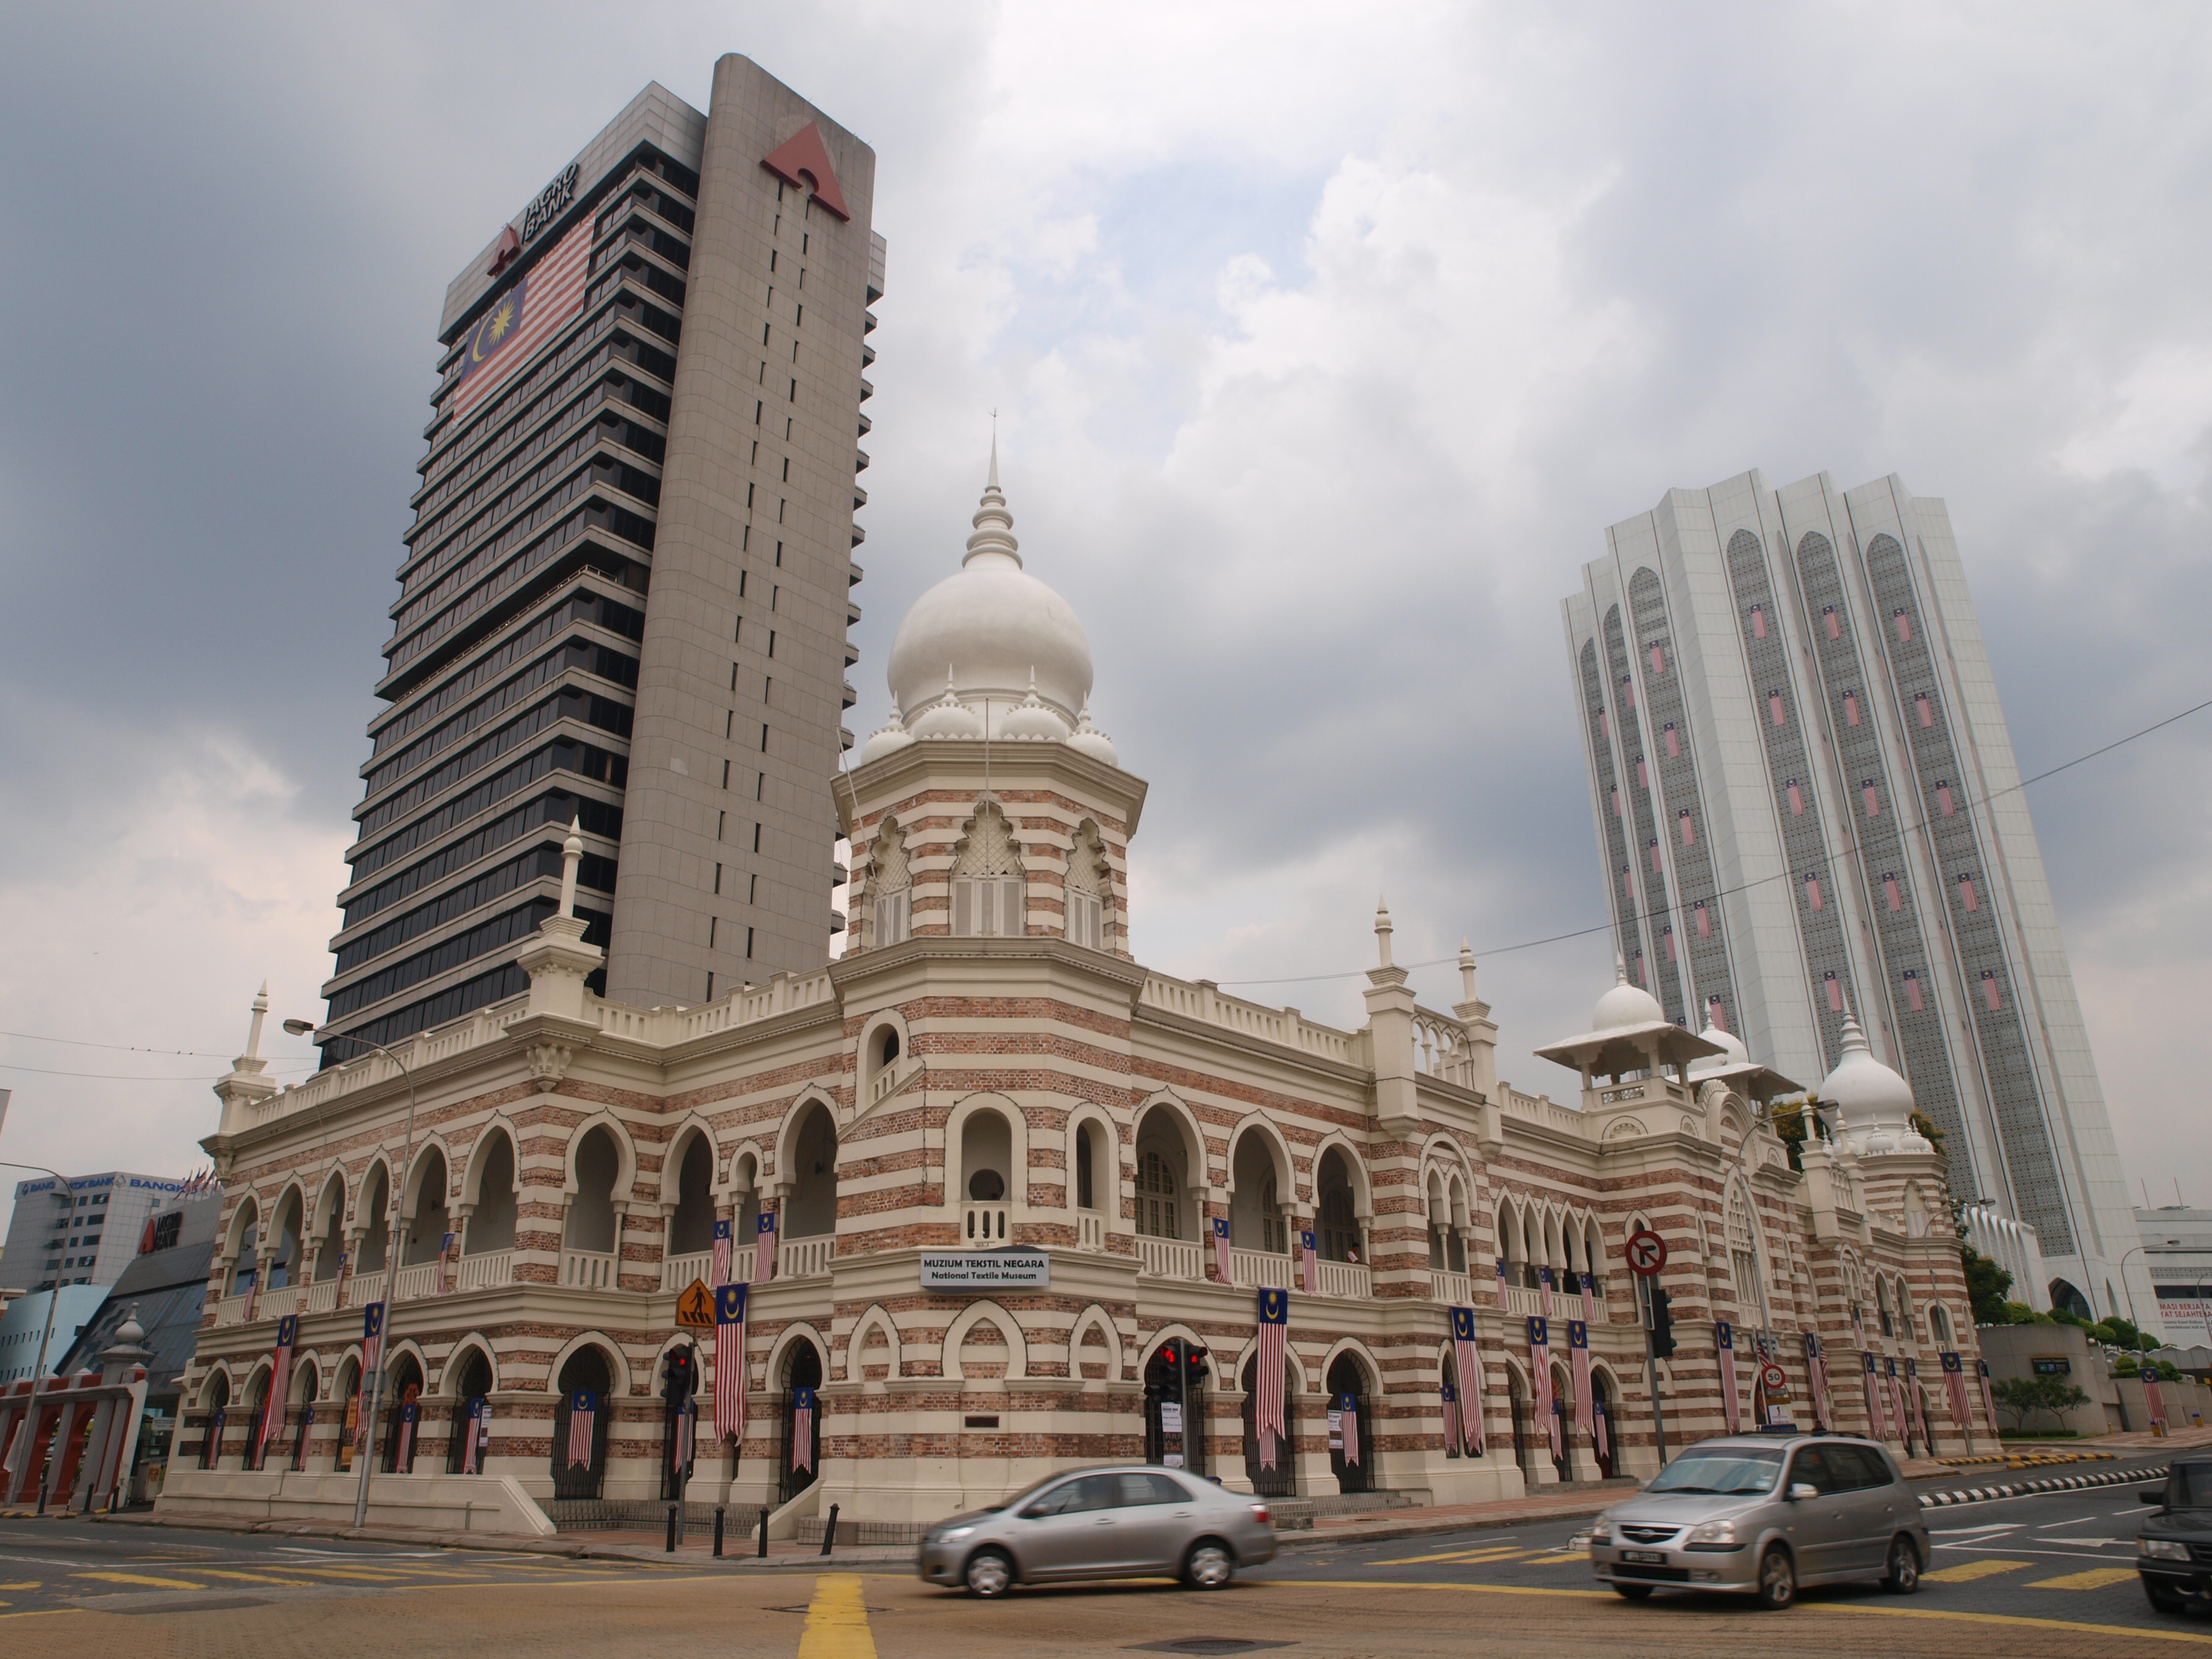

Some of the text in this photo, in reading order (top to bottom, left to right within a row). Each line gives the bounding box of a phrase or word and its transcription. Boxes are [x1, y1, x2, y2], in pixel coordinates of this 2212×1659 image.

[527, 163, 579, 222] AGRO
[525, 178, 576, 241] BANK
[89, 1177, 115, 1187] BANK
[156, 1229, 179, 1250] BANK
[924, 1259, 1044, 1268] MUZIUM TEKSTIL NEGARA
